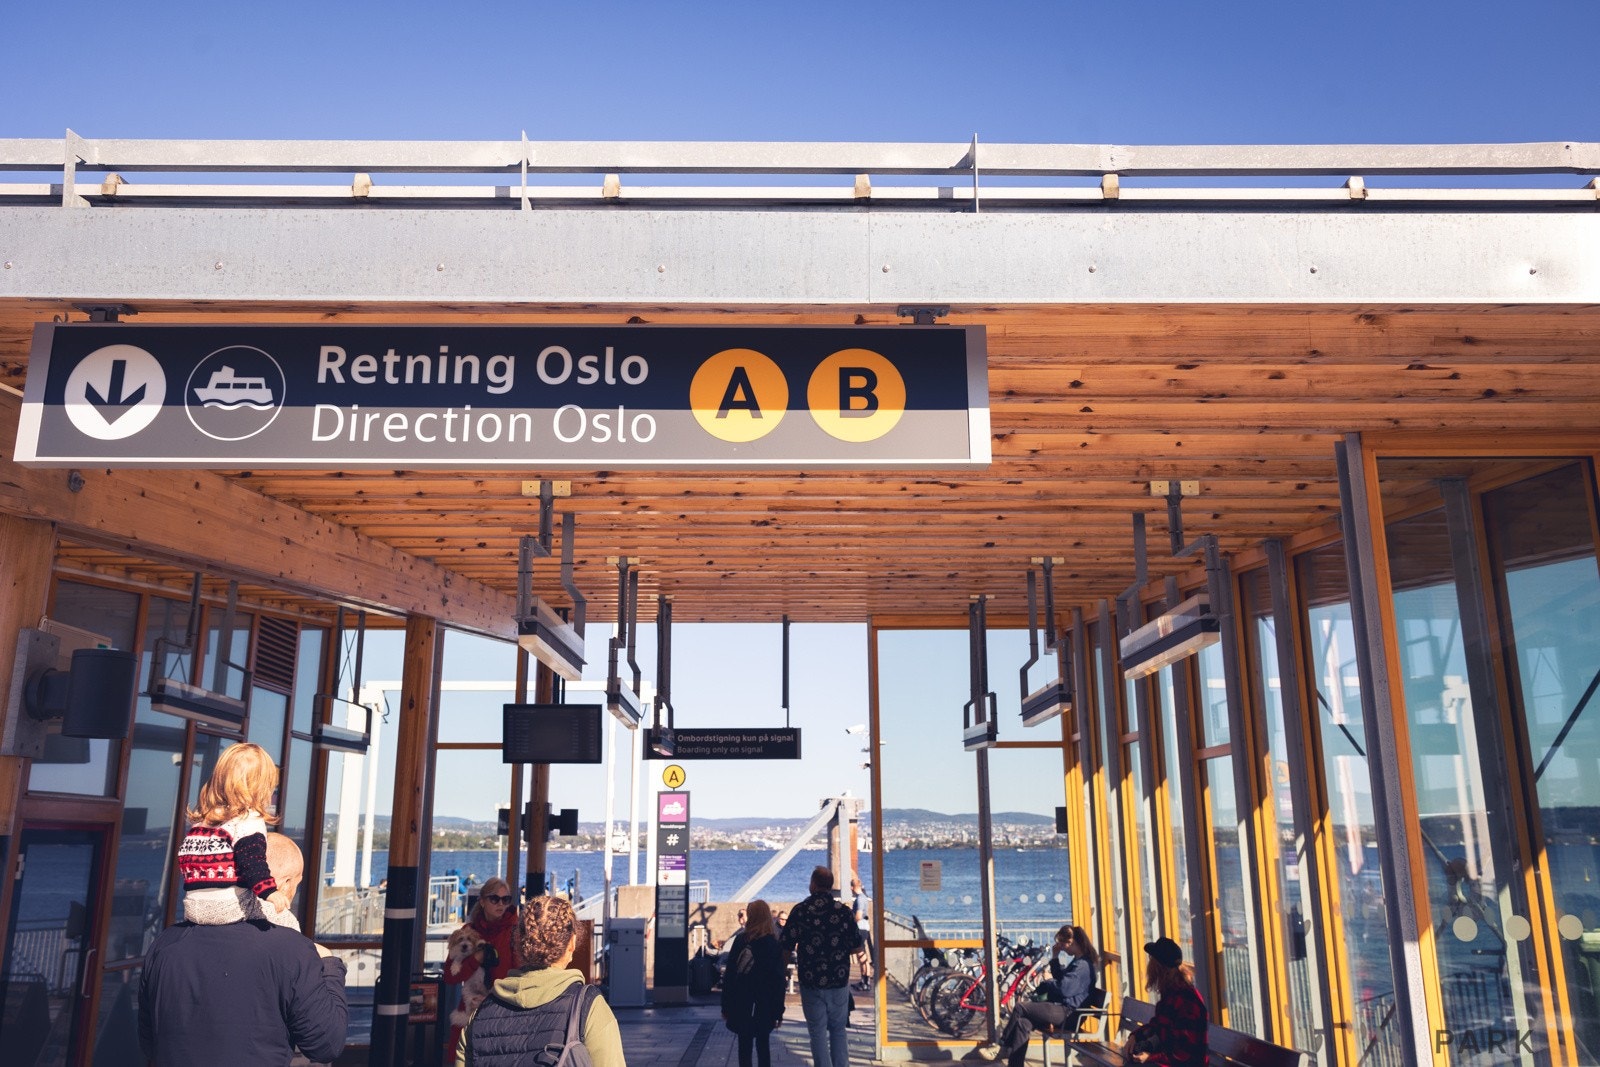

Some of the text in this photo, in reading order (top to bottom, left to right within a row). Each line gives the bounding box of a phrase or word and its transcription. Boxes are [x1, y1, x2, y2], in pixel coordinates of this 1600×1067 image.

[317, 345, 650, 395] Retning Oslo
[715, 366, 879, 419] A B
[311, 404, 657, 443] Direction Oslo
[677, 733, 794, 744] Ombordstigning kun på signal
[677, 746, 711, 755] Boarding
[712, 746, 728, 755] only
[741, 746, 763, 755] signal
[669, 770, 679, 783] A
